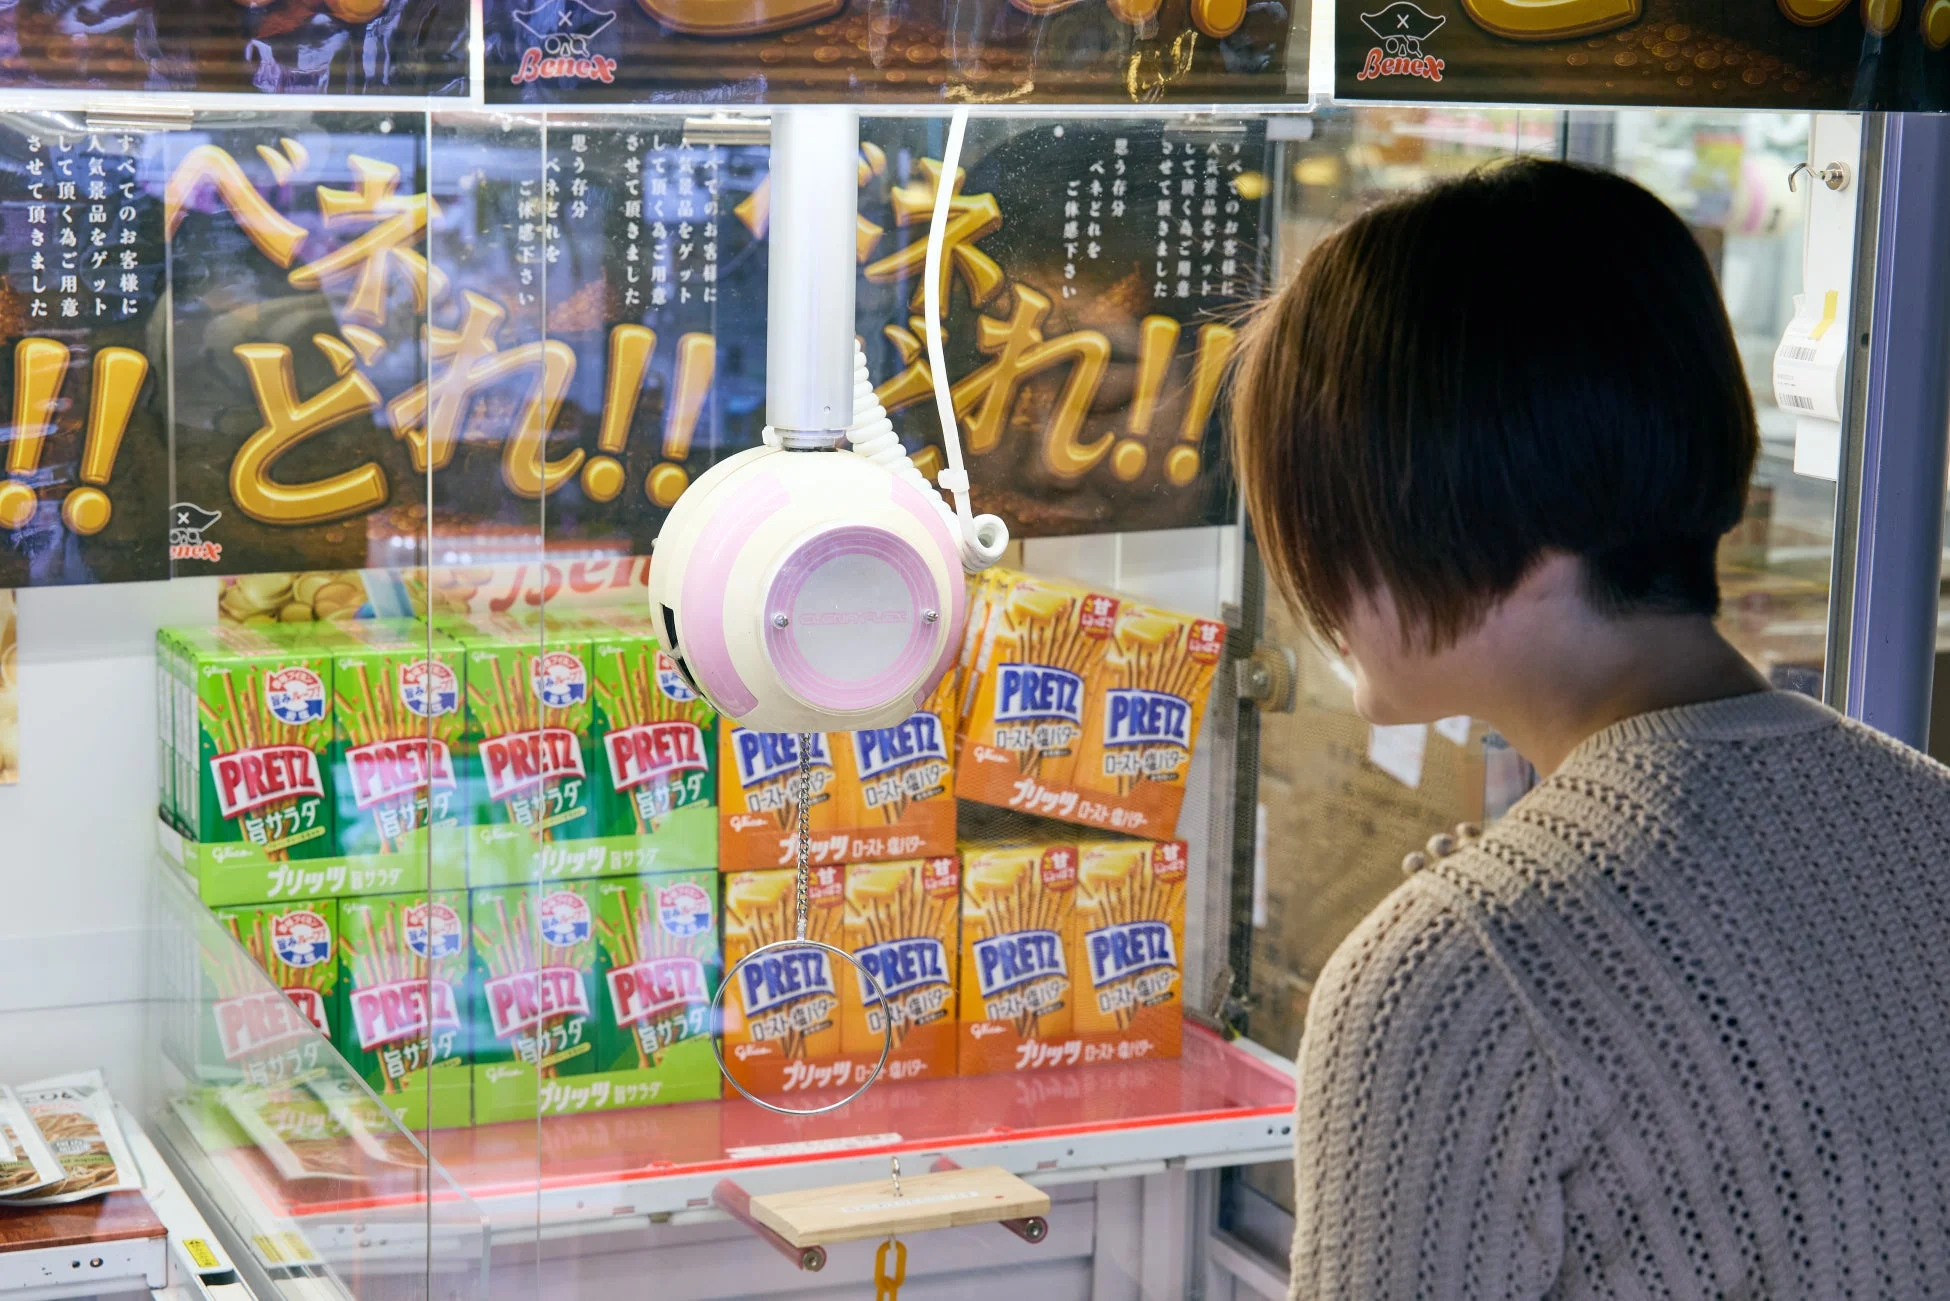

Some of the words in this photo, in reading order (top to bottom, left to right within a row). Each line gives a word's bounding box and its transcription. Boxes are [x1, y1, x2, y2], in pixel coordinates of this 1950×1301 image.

[511, 46, 617, 84] Benex
[1356, 47, 1446, 82] Benex
[571, 134, 589, 219] 思う存分
[1111, 138, 1129, 217] 思う存分
[26, 135, 48, 317] させて頂きました
[58, 135, 79, 318] して頂く為ご用意
[88, 135, 107, 316] 人気景品をゲット
[117, 135, 139, 315] すべてのお客様に
[517, 180, 535, 303] ご体感下さい
[625, 135, 641, 305] させて頂きました
[1002, 670, 1079, 713] PRETZ
[1109, 695, 1186, 739] PRETZ
[354, 741, 447, 798] PRETZ
[487, 733, 577, 788] PRETZ
[612, 726, 700, 781] PRETZ
[857, 716, 940, 769] PRETZ
[219, 749, 315, 807] PRETZ
[1009, 777, 1080, 816] プリッツ
[267, 864, 346, 897] プリッツ
[744, 951, 828, 1008] PRETZ
[860, 942, 943, 998] PRETZ
[980, 934, 1060, 989] PRETZ
[1092, 925, 1170, 978] PRETZ
[358, 982, 450, 1041] PRETZ
[492, 974, 580, 1031] PRETZ
[614, 960, 703, 1017] PRETZ
[782, 1060, 852, 1092] プリッツ
[1015, 1039, 1083, 1070] プリッツ
[540, 1080, 611, 1113] プリッツ
